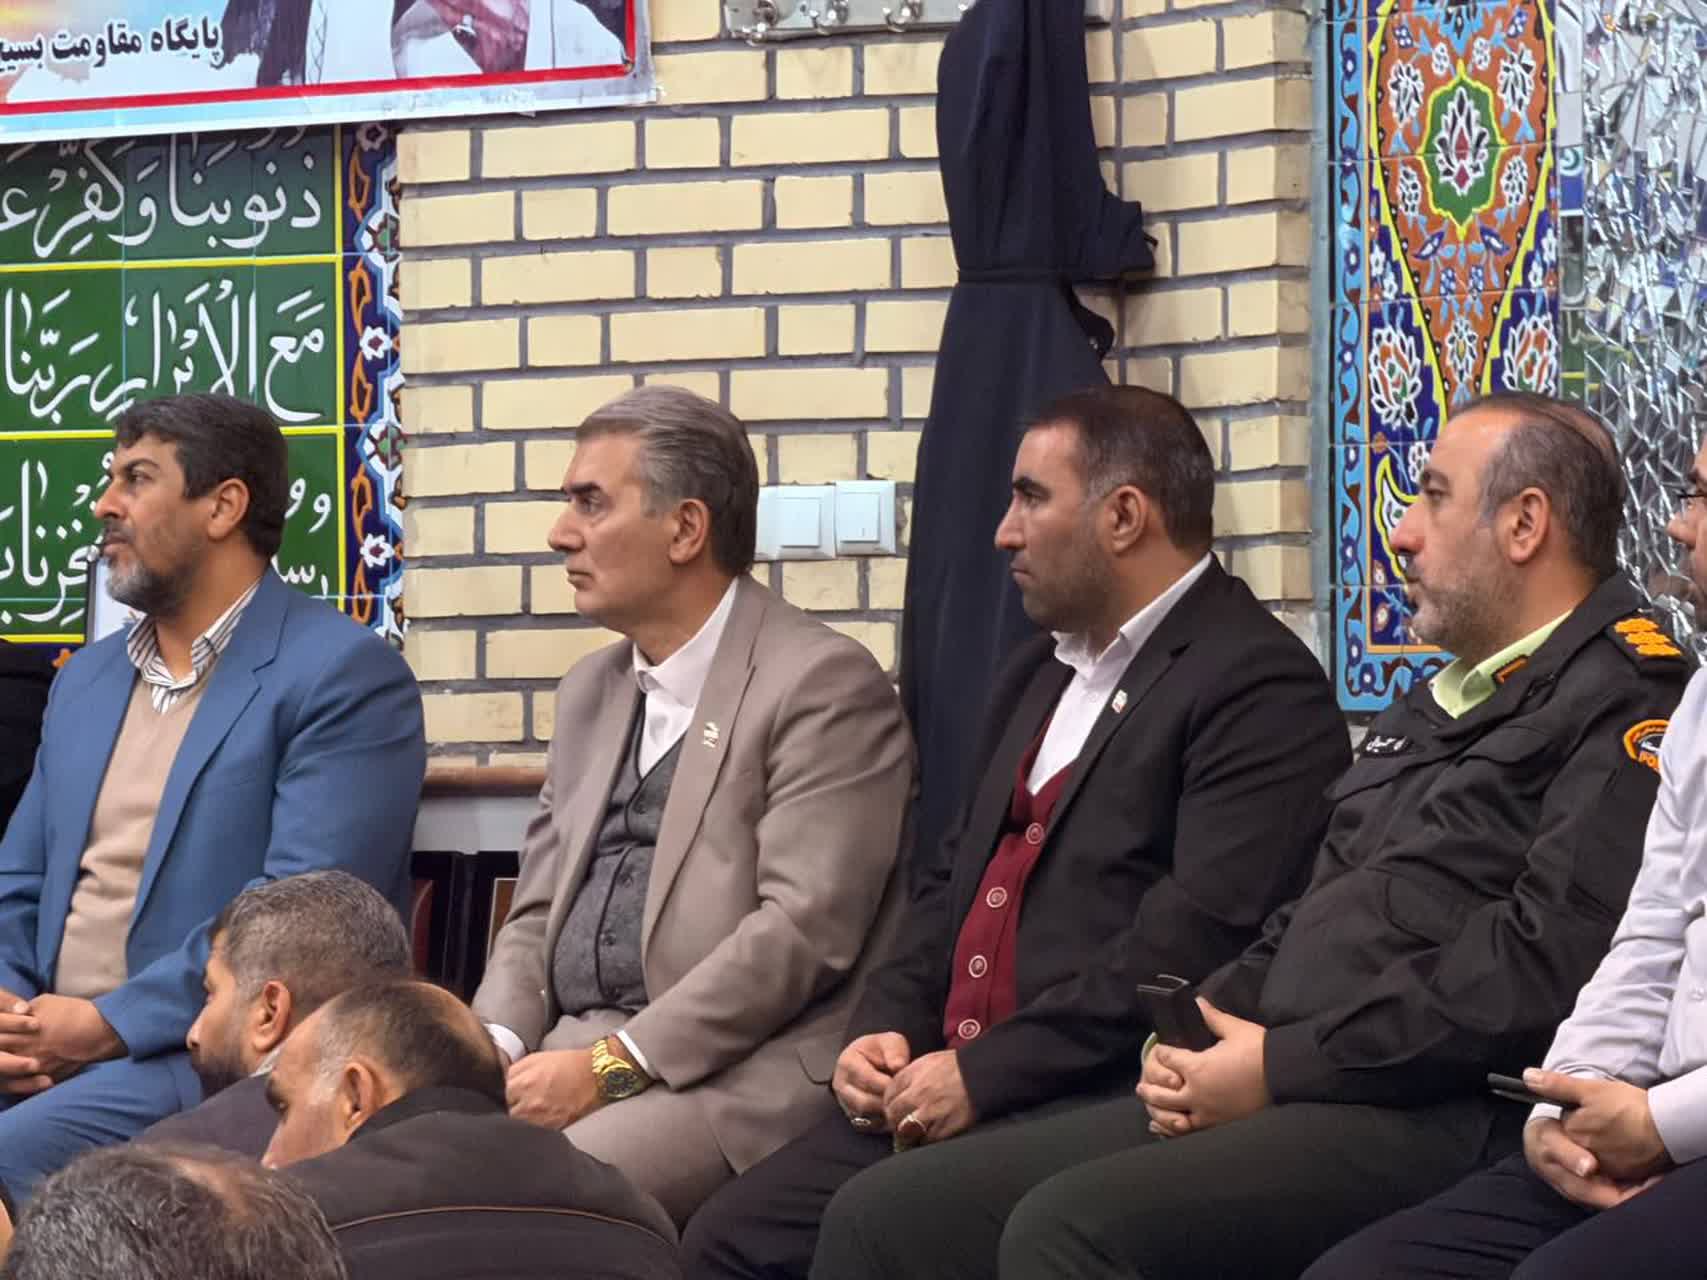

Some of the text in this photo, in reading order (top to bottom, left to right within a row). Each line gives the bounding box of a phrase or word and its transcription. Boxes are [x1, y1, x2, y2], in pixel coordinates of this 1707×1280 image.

[0, 17, 222, 72] پایگاه مقاومت بسی
